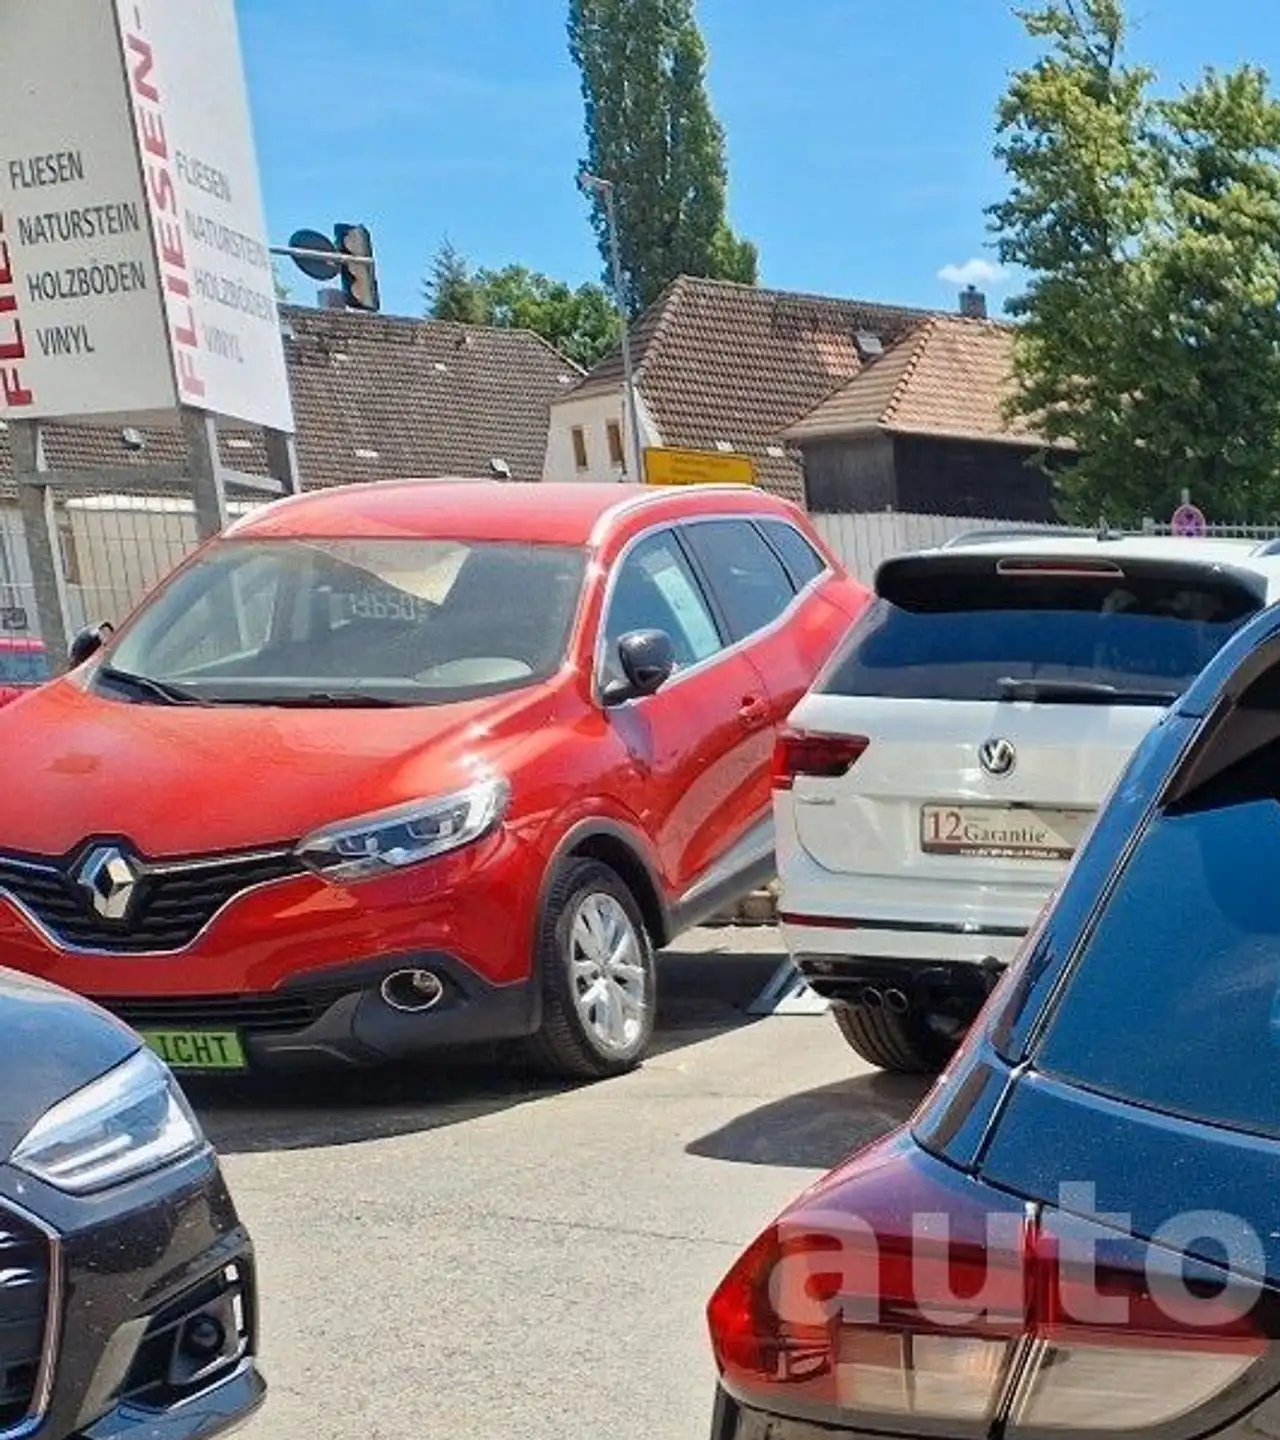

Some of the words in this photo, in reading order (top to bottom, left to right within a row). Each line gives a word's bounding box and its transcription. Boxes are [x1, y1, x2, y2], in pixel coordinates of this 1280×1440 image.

[9, 150, 84, 190] FLIESEN
[18, 203, 140, 246] NATURSTEIN
[27, 258, 146, 302] HOLZBÖDEN
[37, 324, 96, 356] VINYL
[928, 810, 963, 841] 12
[156, 1034, 229, 1064] ICHT
